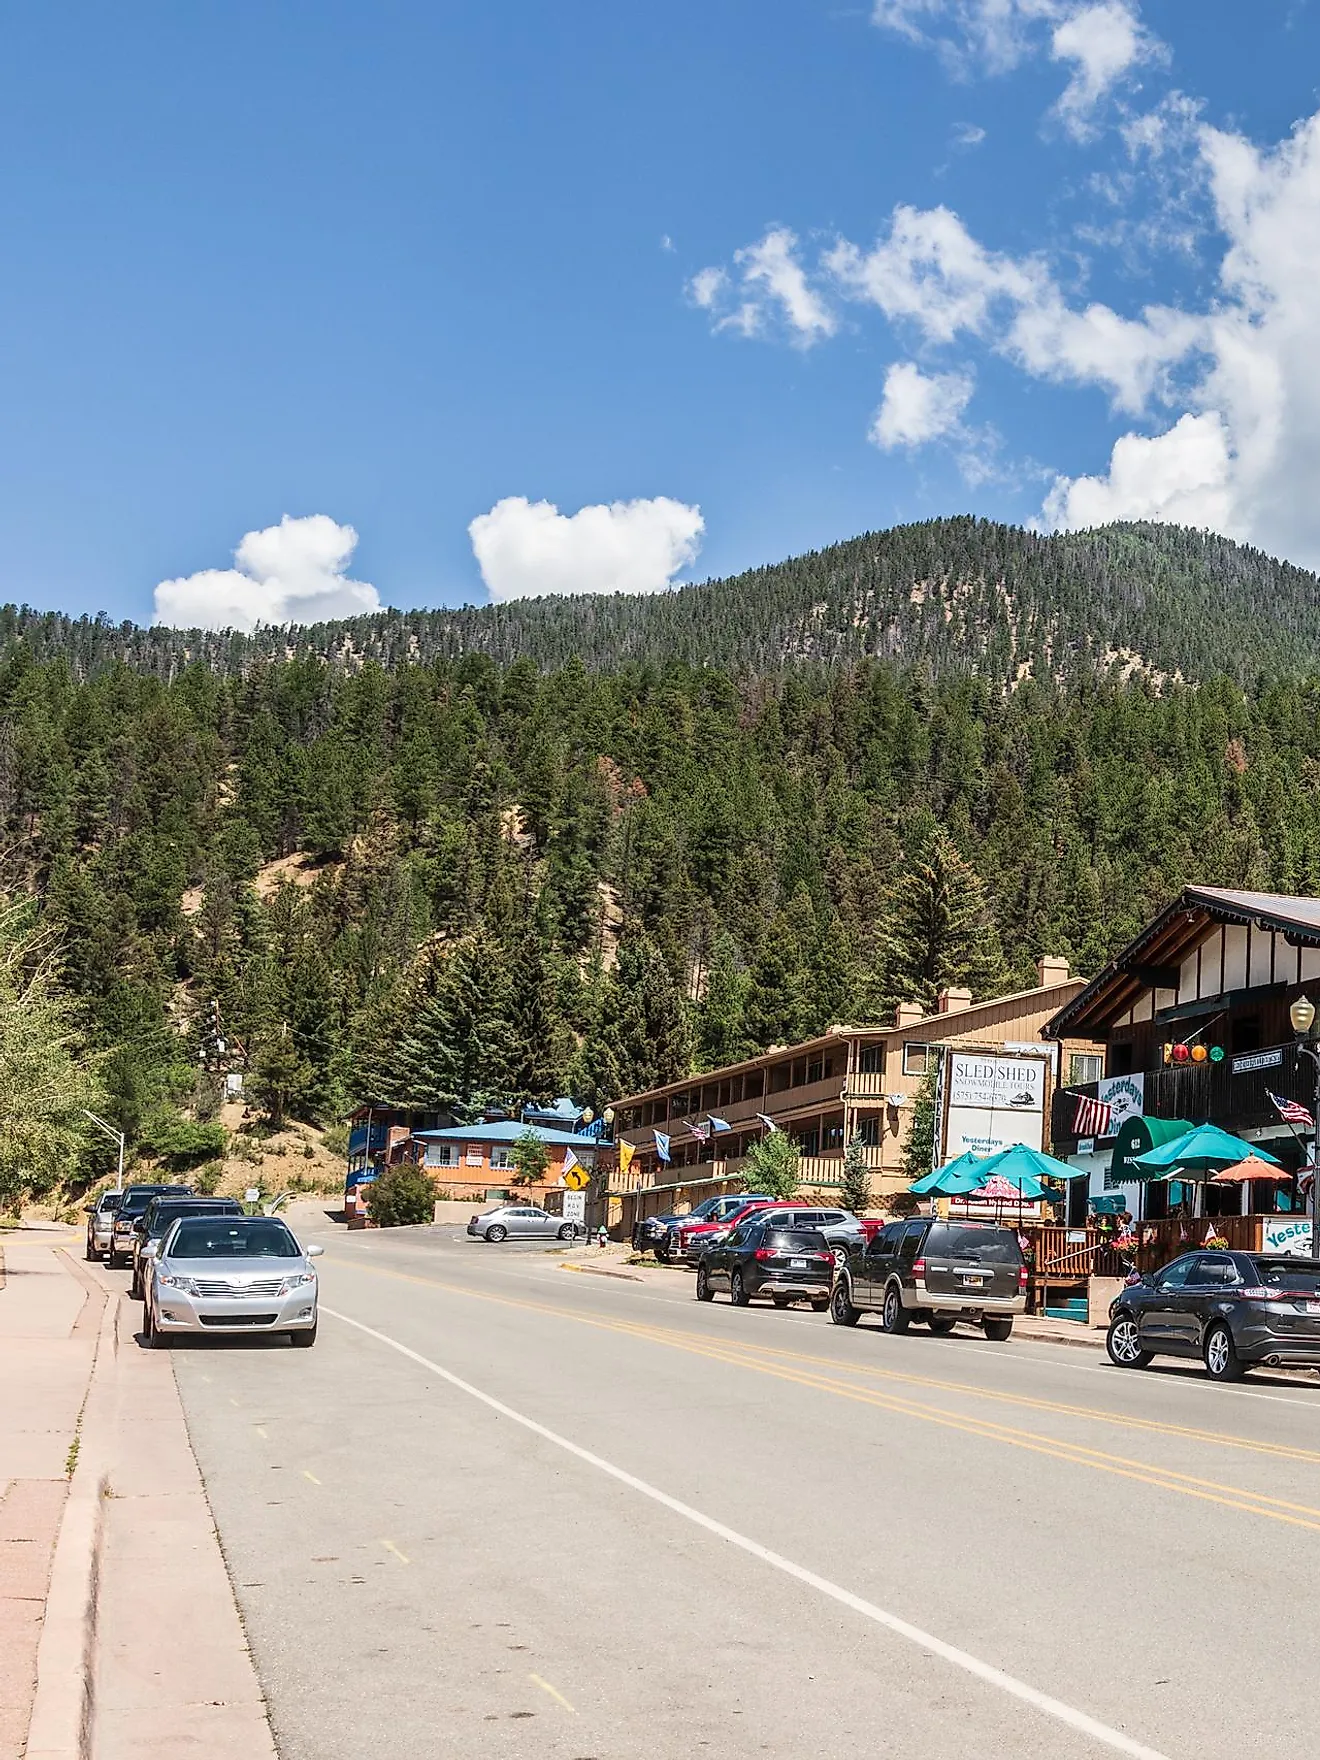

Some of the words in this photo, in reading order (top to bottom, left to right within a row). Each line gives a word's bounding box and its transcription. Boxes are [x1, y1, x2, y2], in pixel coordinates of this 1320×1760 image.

[955, 1063, 994, 1079] SLED
[997, 1065, 1036, 1082] SHED
[954, 1078, 1008, 1089] SNOWMOBILE
[1010, 1082, 1034, 1091] TOURS
[1101, 1076, 1143, 1107] esterdays
[962, 1135, 1003, 1146] Yesterdays
[971, 1144, 993, 1153] Diner
